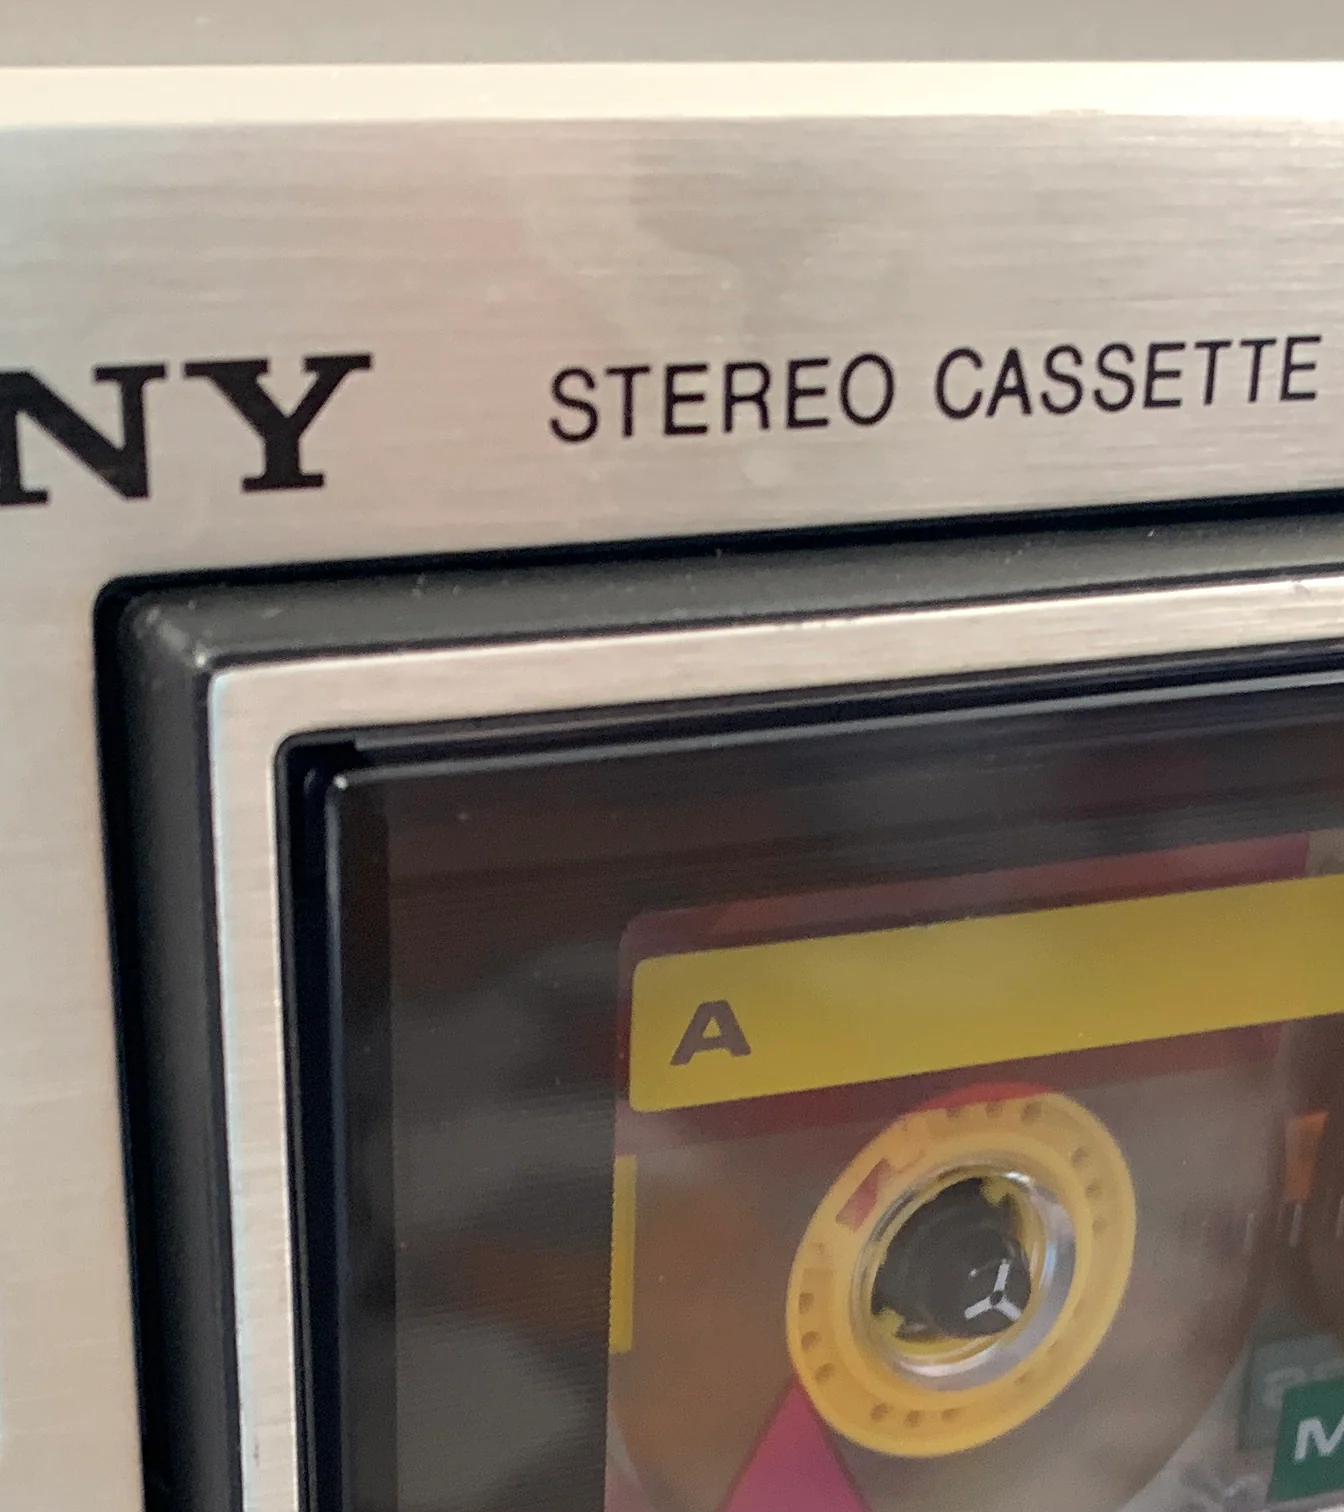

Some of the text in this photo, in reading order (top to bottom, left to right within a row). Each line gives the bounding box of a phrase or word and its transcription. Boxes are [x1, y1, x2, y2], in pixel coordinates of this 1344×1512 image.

[548, 352, 895, 443] STEREO
[935, 334, 1322, 420] CASSETTE
[669, 998, 752, 1067] A
